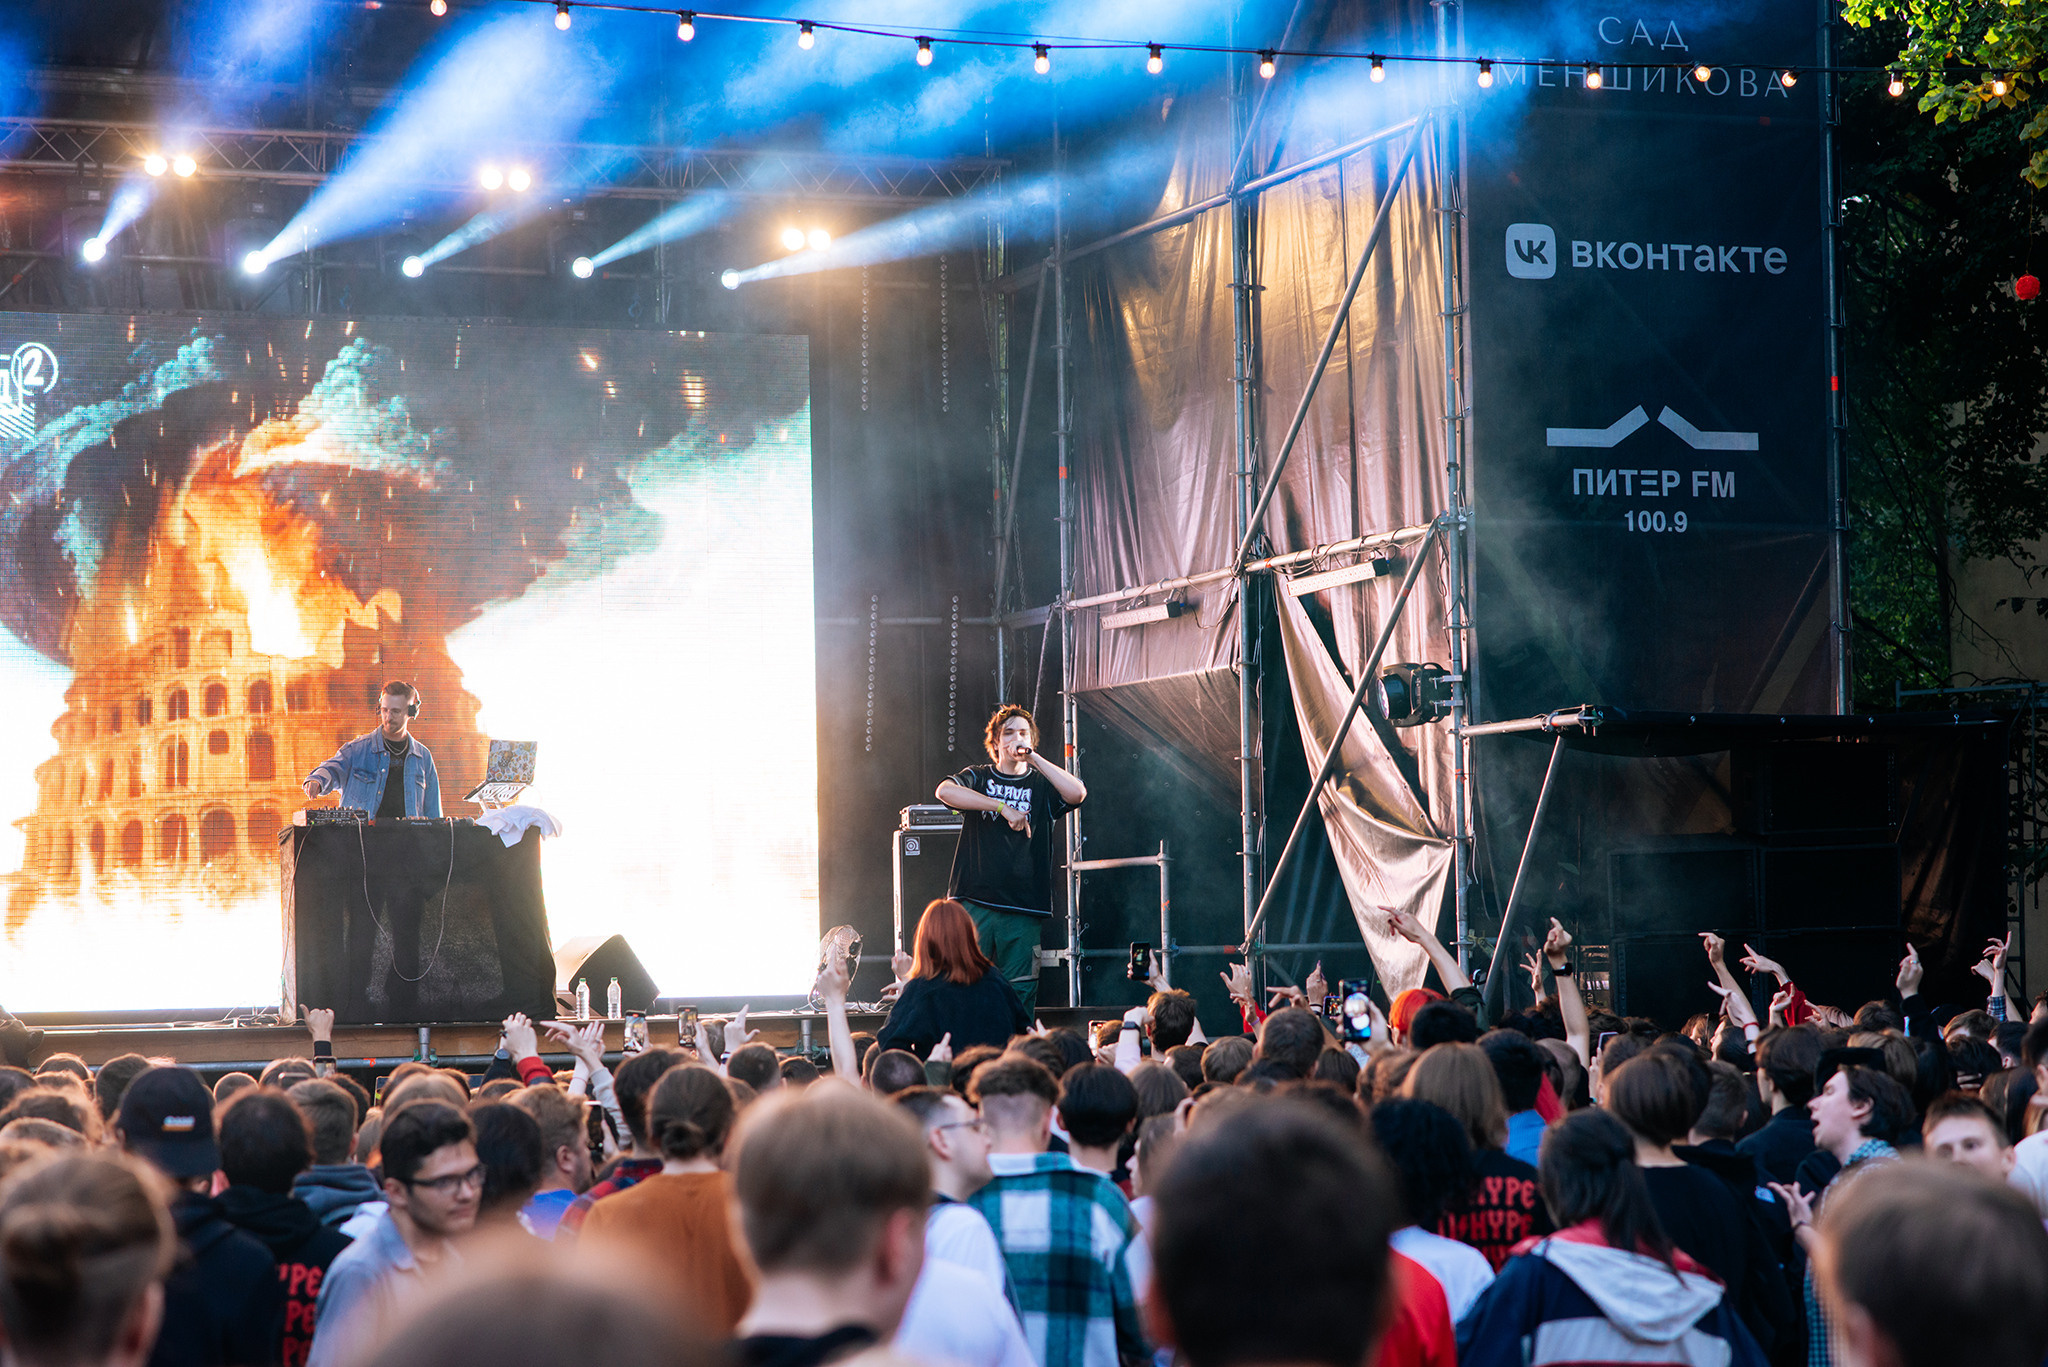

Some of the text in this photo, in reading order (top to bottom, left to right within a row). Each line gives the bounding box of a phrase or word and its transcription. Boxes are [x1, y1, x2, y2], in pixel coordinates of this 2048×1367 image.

[1598, 16, 1689, 51] САД
[1496, 56, 1789, 98] МЕНШИКОВА
[1573, 468, 1735, 498] ПИТЕР FM
[1624, 510, 1688, 533] 100.9
